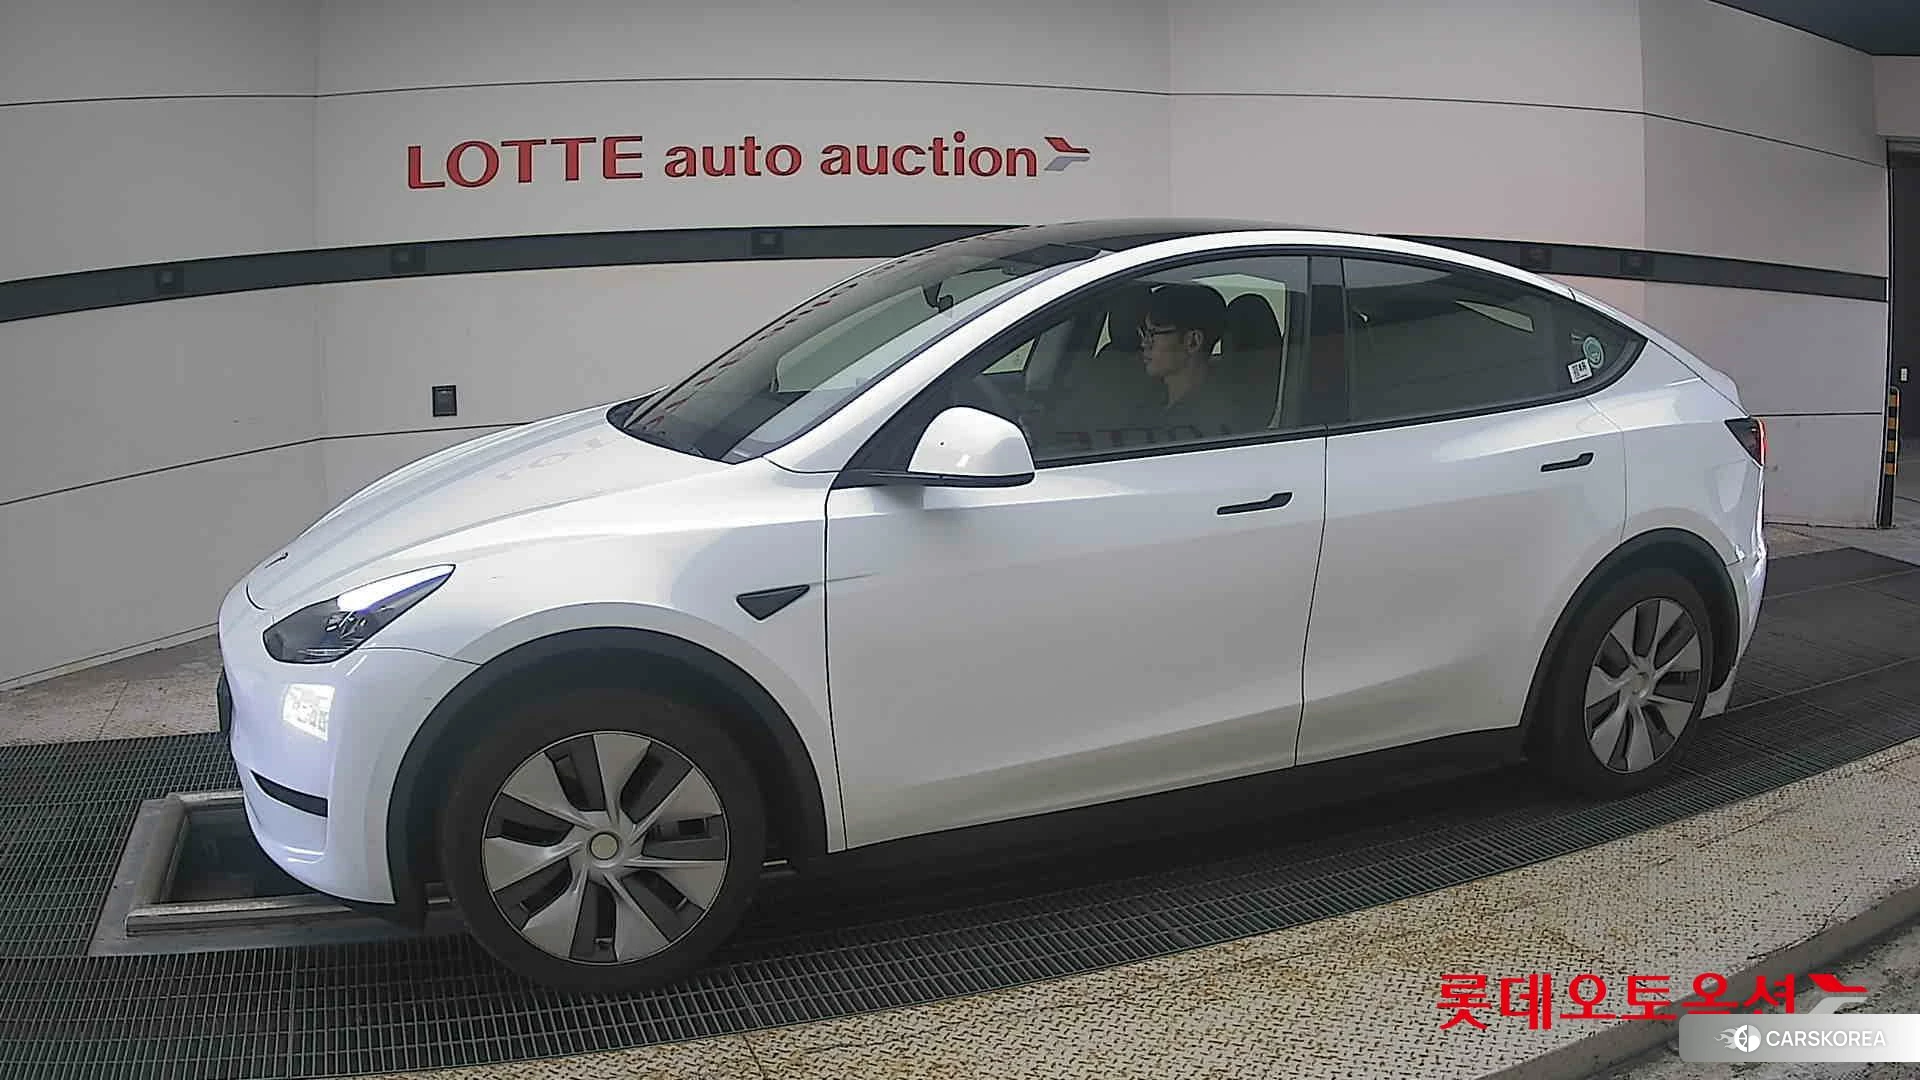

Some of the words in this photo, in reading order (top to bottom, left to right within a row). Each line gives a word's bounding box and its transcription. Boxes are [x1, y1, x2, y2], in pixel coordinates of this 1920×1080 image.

[406, 136, 643, 190] LOTTE
[664, 136, 803, 178] auto
[819, 131, 1038, 178] auction
